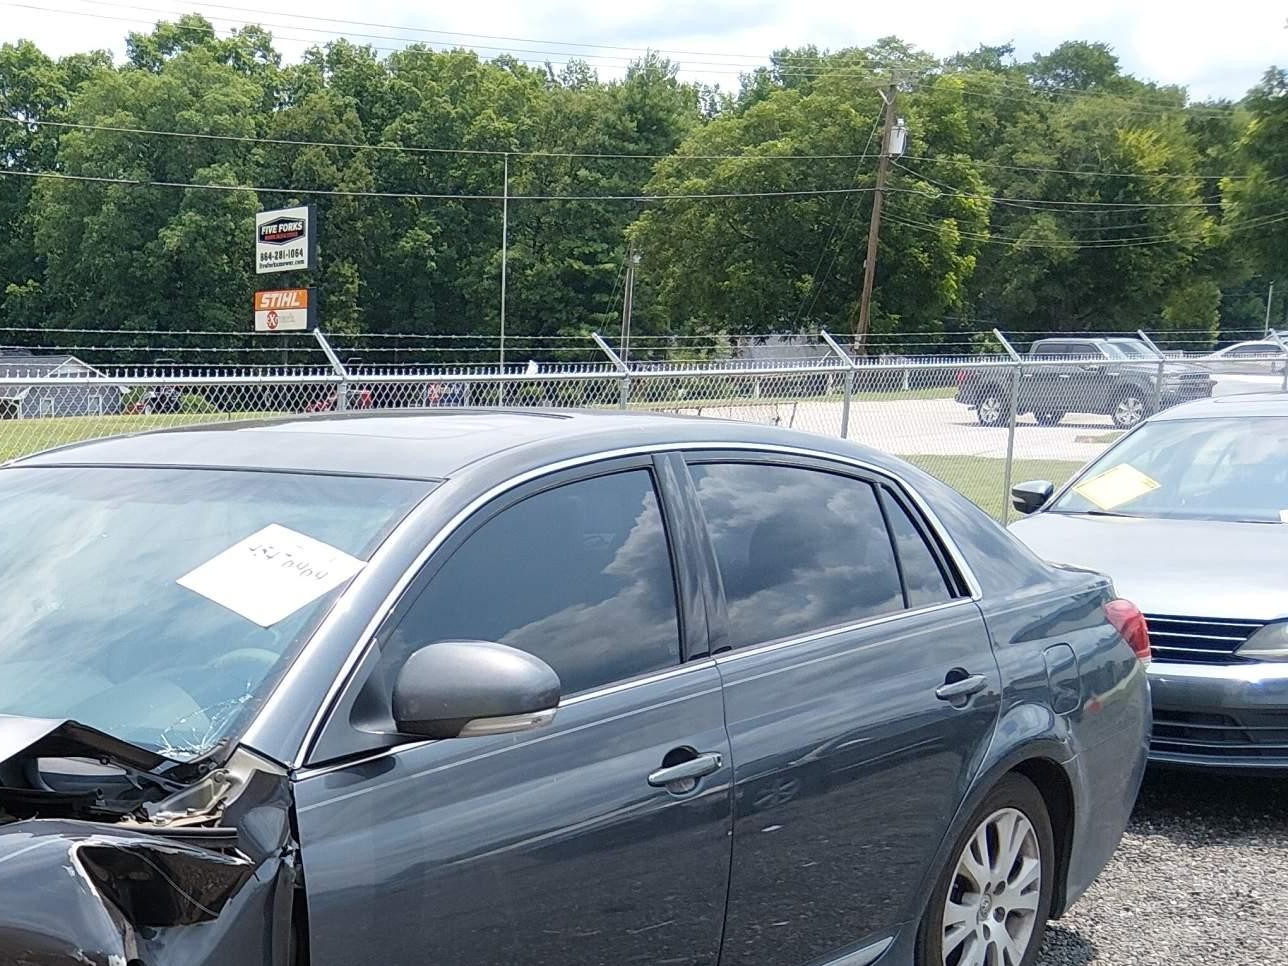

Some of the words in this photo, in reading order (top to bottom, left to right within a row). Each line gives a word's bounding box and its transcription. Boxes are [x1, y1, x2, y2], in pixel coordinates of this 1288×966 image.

[261, 224, 278, 235] FIVE
[278, 221, 303, 232] FORKS
[260, 292, 299, 307] STIHL
